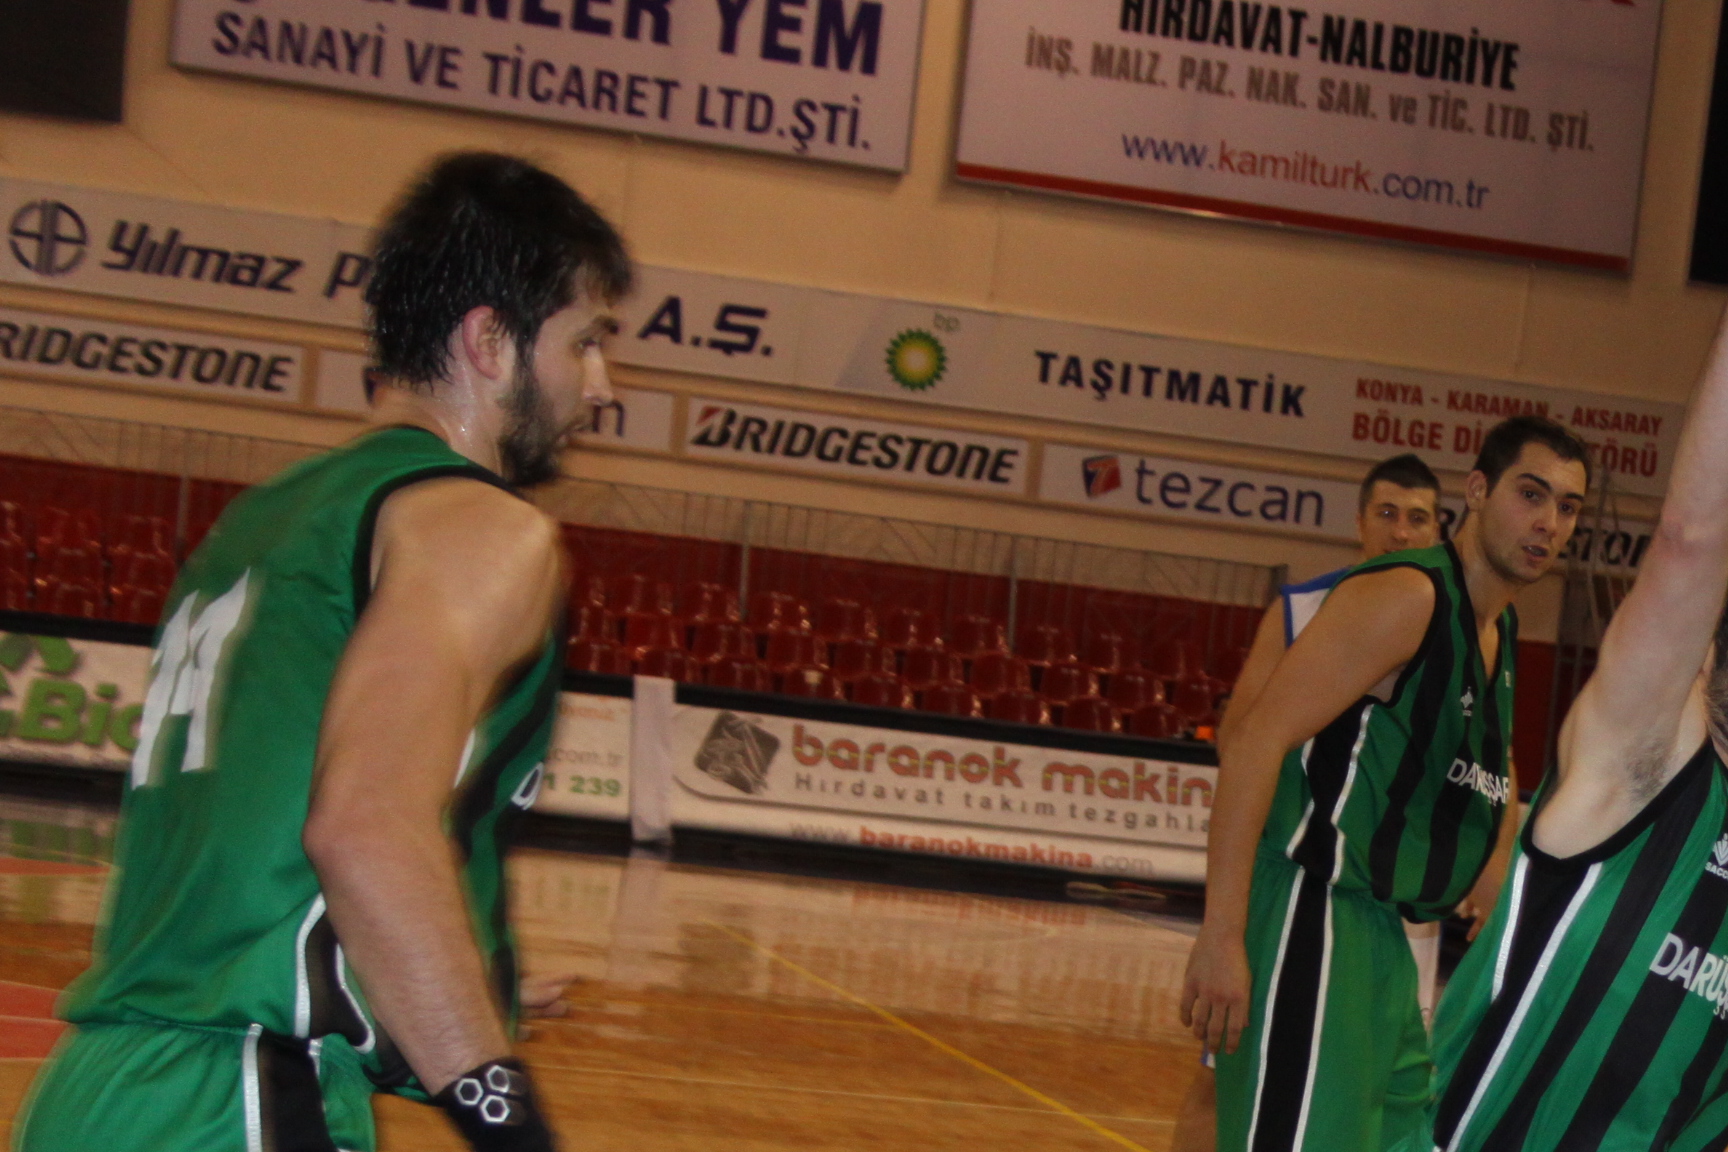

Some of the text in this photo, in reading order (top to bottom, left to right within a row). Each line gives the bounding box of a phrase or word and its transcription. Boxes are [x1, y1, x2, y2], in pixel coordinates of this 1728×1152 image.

[715, 0, 884, 76] YEM
[212, 10, 386, 78] SANAYİ
[404, 38, 463, 90] VE
[482, 44, 682, 121] TİCARET
[695, 83, 872, 155] LTD.ŞTİ.
[1025, 25, 1080, 78] İNŞ.
[1090, 41, 1168, 88] MALZ.
[1178, 53, 1236, 98] PAZ.
[1246, 65, 1308, 109] NAK.
[1317, 76, 1378, 120] SAN.
[1427, 90, 1475, 134] TİC.
[1484, 103, 1537, 144] LTD.
[1546, 109, 1595, 152] ŞTİ.
[1121, 133, 1491, 209] www.kamilturk.com.tr
[636, 295, 774, 357] A.Ş.
[932, 310, 961, 333] bp
[0, 321, 294, 393] RIDGESTONE
[1034, 349, 1307, 418] TAŞITMATİK
[1351, 408, 1444, 450] BÖLGE
[1355, 376, 1424, 407] KONYA
[1446, 389, 1551, 421] KARAMAN
[1571, 405, 1664, 437] AKSARAY
[691, 404, 1019, 484] BRIDGESTONE
[1134, 458, 1324, 527] tezcan
[792, 723, 1213, 808] baranok makin
[1069, 800, 1210, 833] tezgahla
